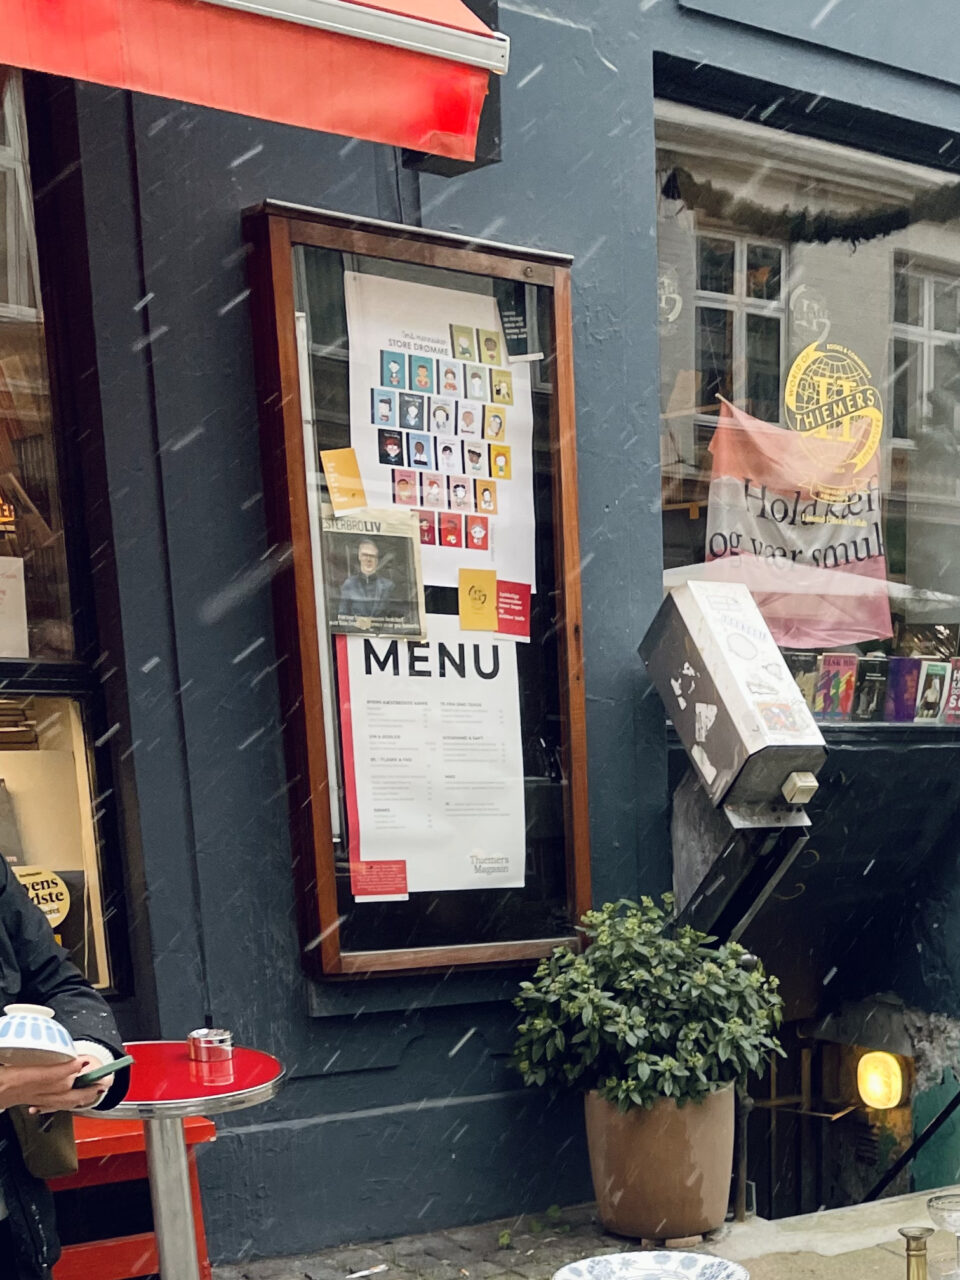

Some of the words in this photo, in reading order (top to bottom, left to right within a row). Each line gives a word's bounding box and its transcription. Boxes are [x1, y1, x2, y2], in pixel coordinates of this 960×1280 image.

[388, 338, 412, 350] STORE
[413, 342, 449, 356] DRØMME
[787, 362, 803, 397] WORLD
[800, 352, 812, 366] OF
[794, 389, 875, 431] THIEMERS
[744, 477, 817, 527] Hold
[709, 531, 743, 568] og
[363, 638, 500, 680] MENU
[22, 878, 59, 893] yens
